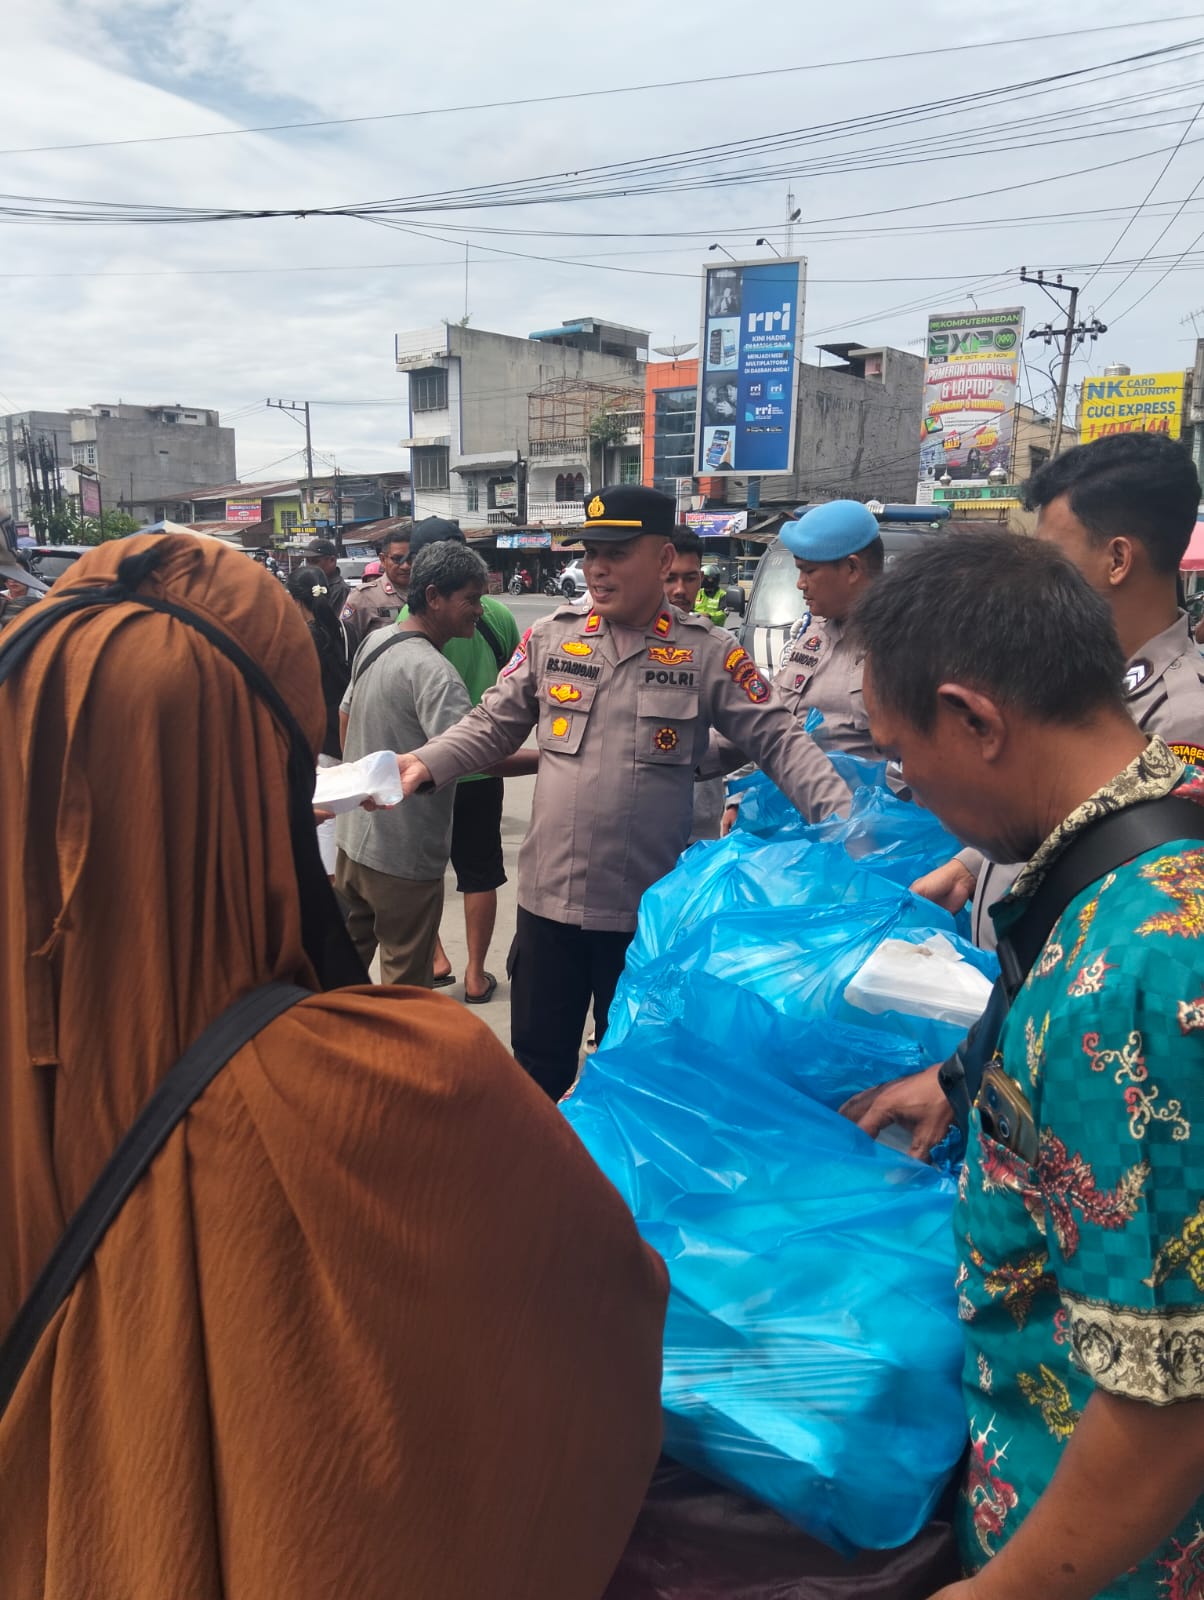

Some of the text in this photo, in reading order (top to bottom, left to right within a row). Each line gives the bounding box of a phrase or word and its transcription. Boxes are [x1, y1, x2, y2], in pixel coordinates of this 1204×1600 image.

[748, 303, 790, 332] rri
[941, 315, 1019, 328] KOMPUTERMEDAN
[928, 361, 1013, 383] PAMERAN KOMPUTER
[942, 378, 993, 398] & LAPTOP
[1087, 378, 1155, 400] NK CARD
[1126, 385, 1178, 397] LAUNDRY
[755, 403, 772, 415] rri
[1087, 401, 1176, 419] CUCI EXPRESS
[645, 670, 694, 686] POLRI
